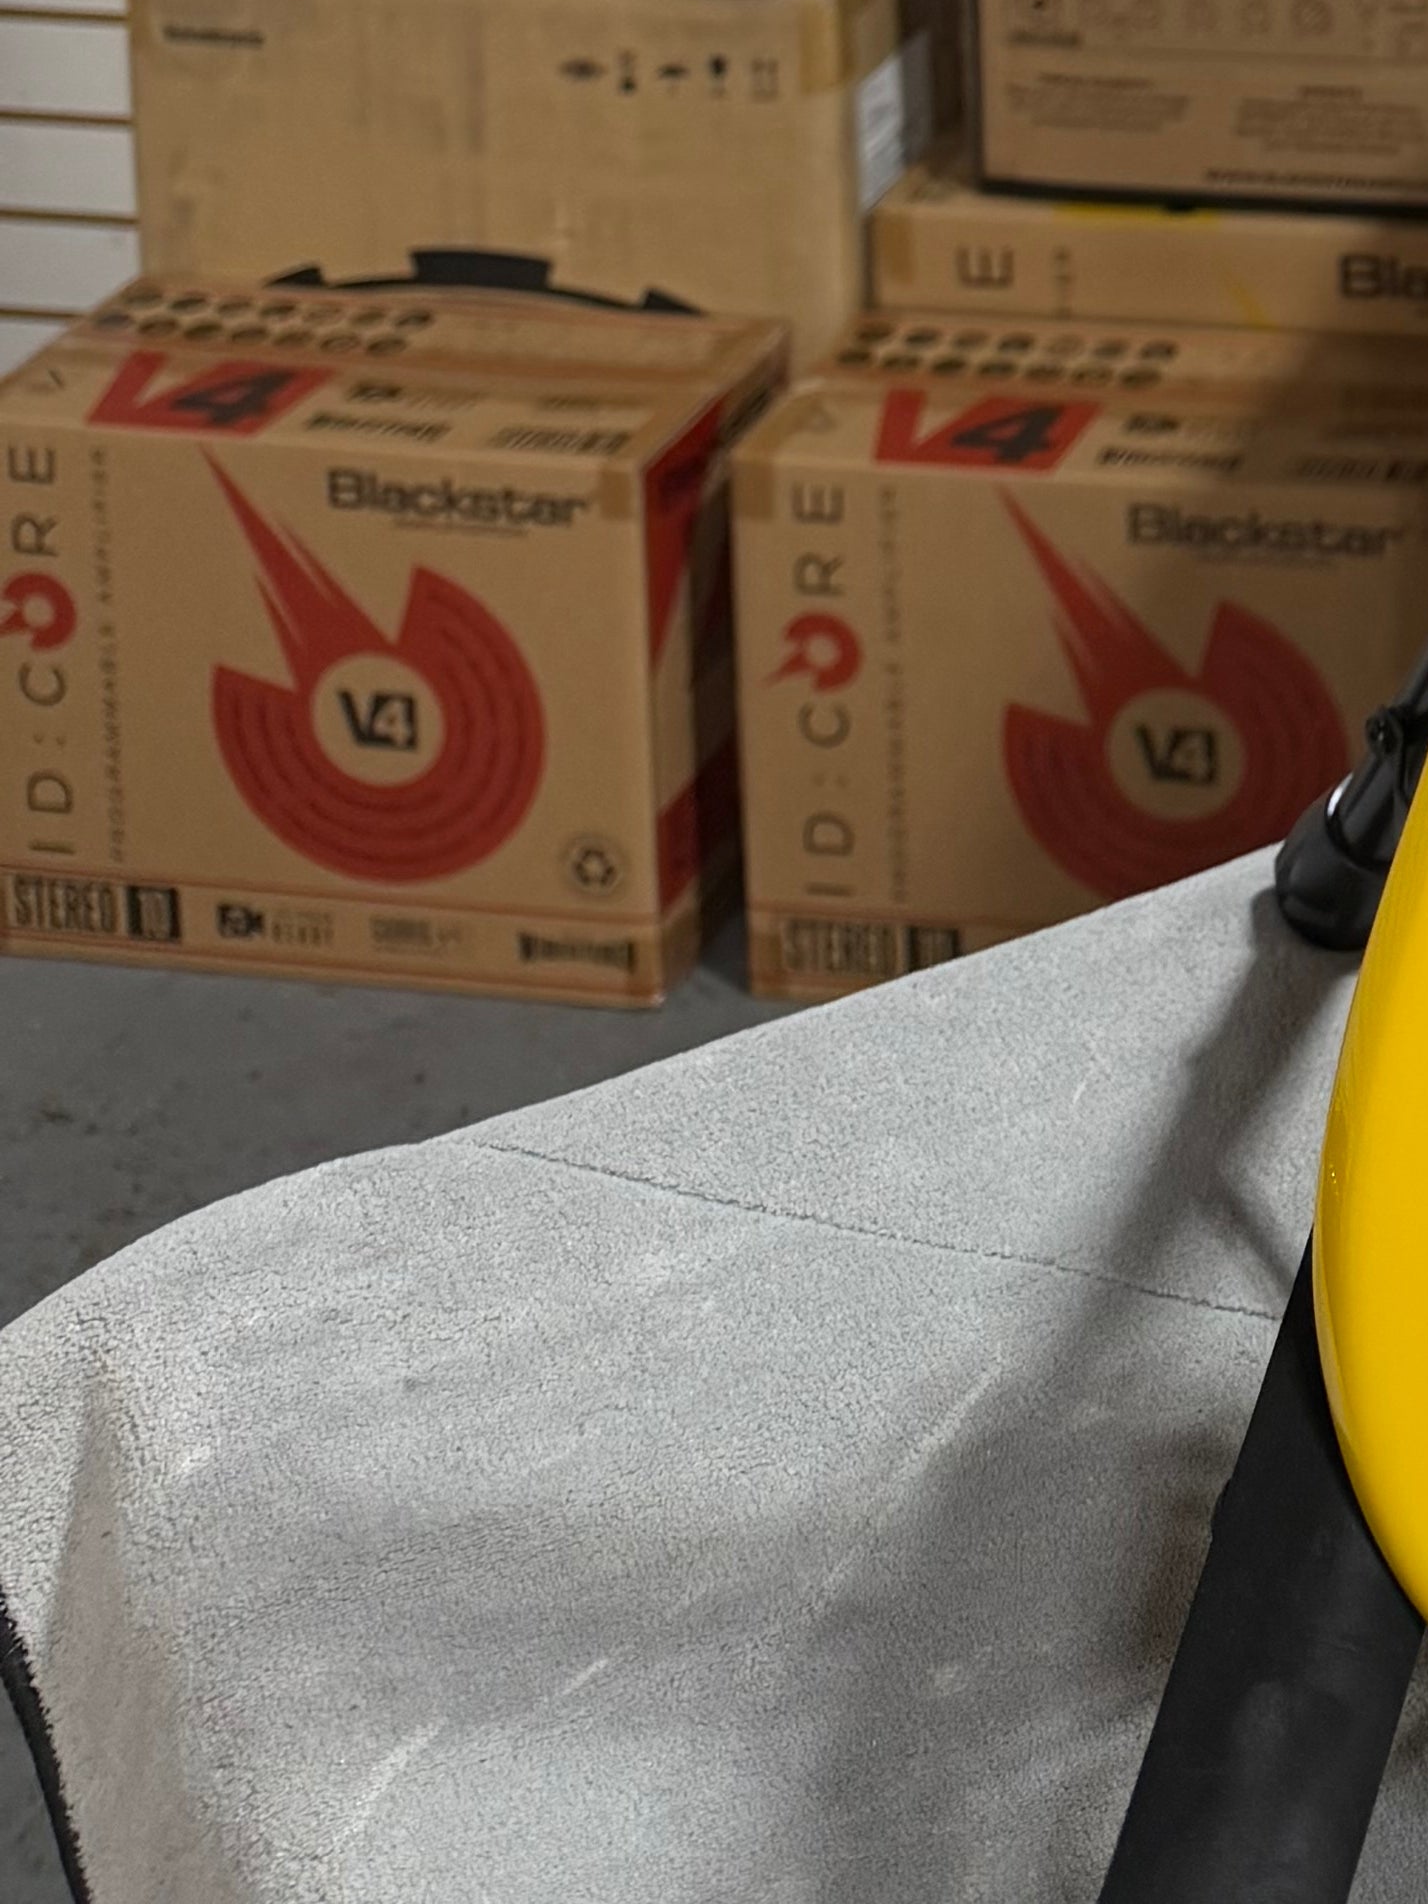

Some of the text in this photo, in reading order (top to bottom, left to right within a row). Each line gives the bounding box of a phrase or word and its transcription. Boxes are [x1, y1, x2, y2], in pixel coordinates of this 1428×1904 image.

[85, 350, 340, 440] V4
[873, 389, 1104, 476] V4
[327, 468, 589, 528] Blackstar
[1127, 502, 1404, 557] Blackstar
[10, 875, 116, 935] STEREO
